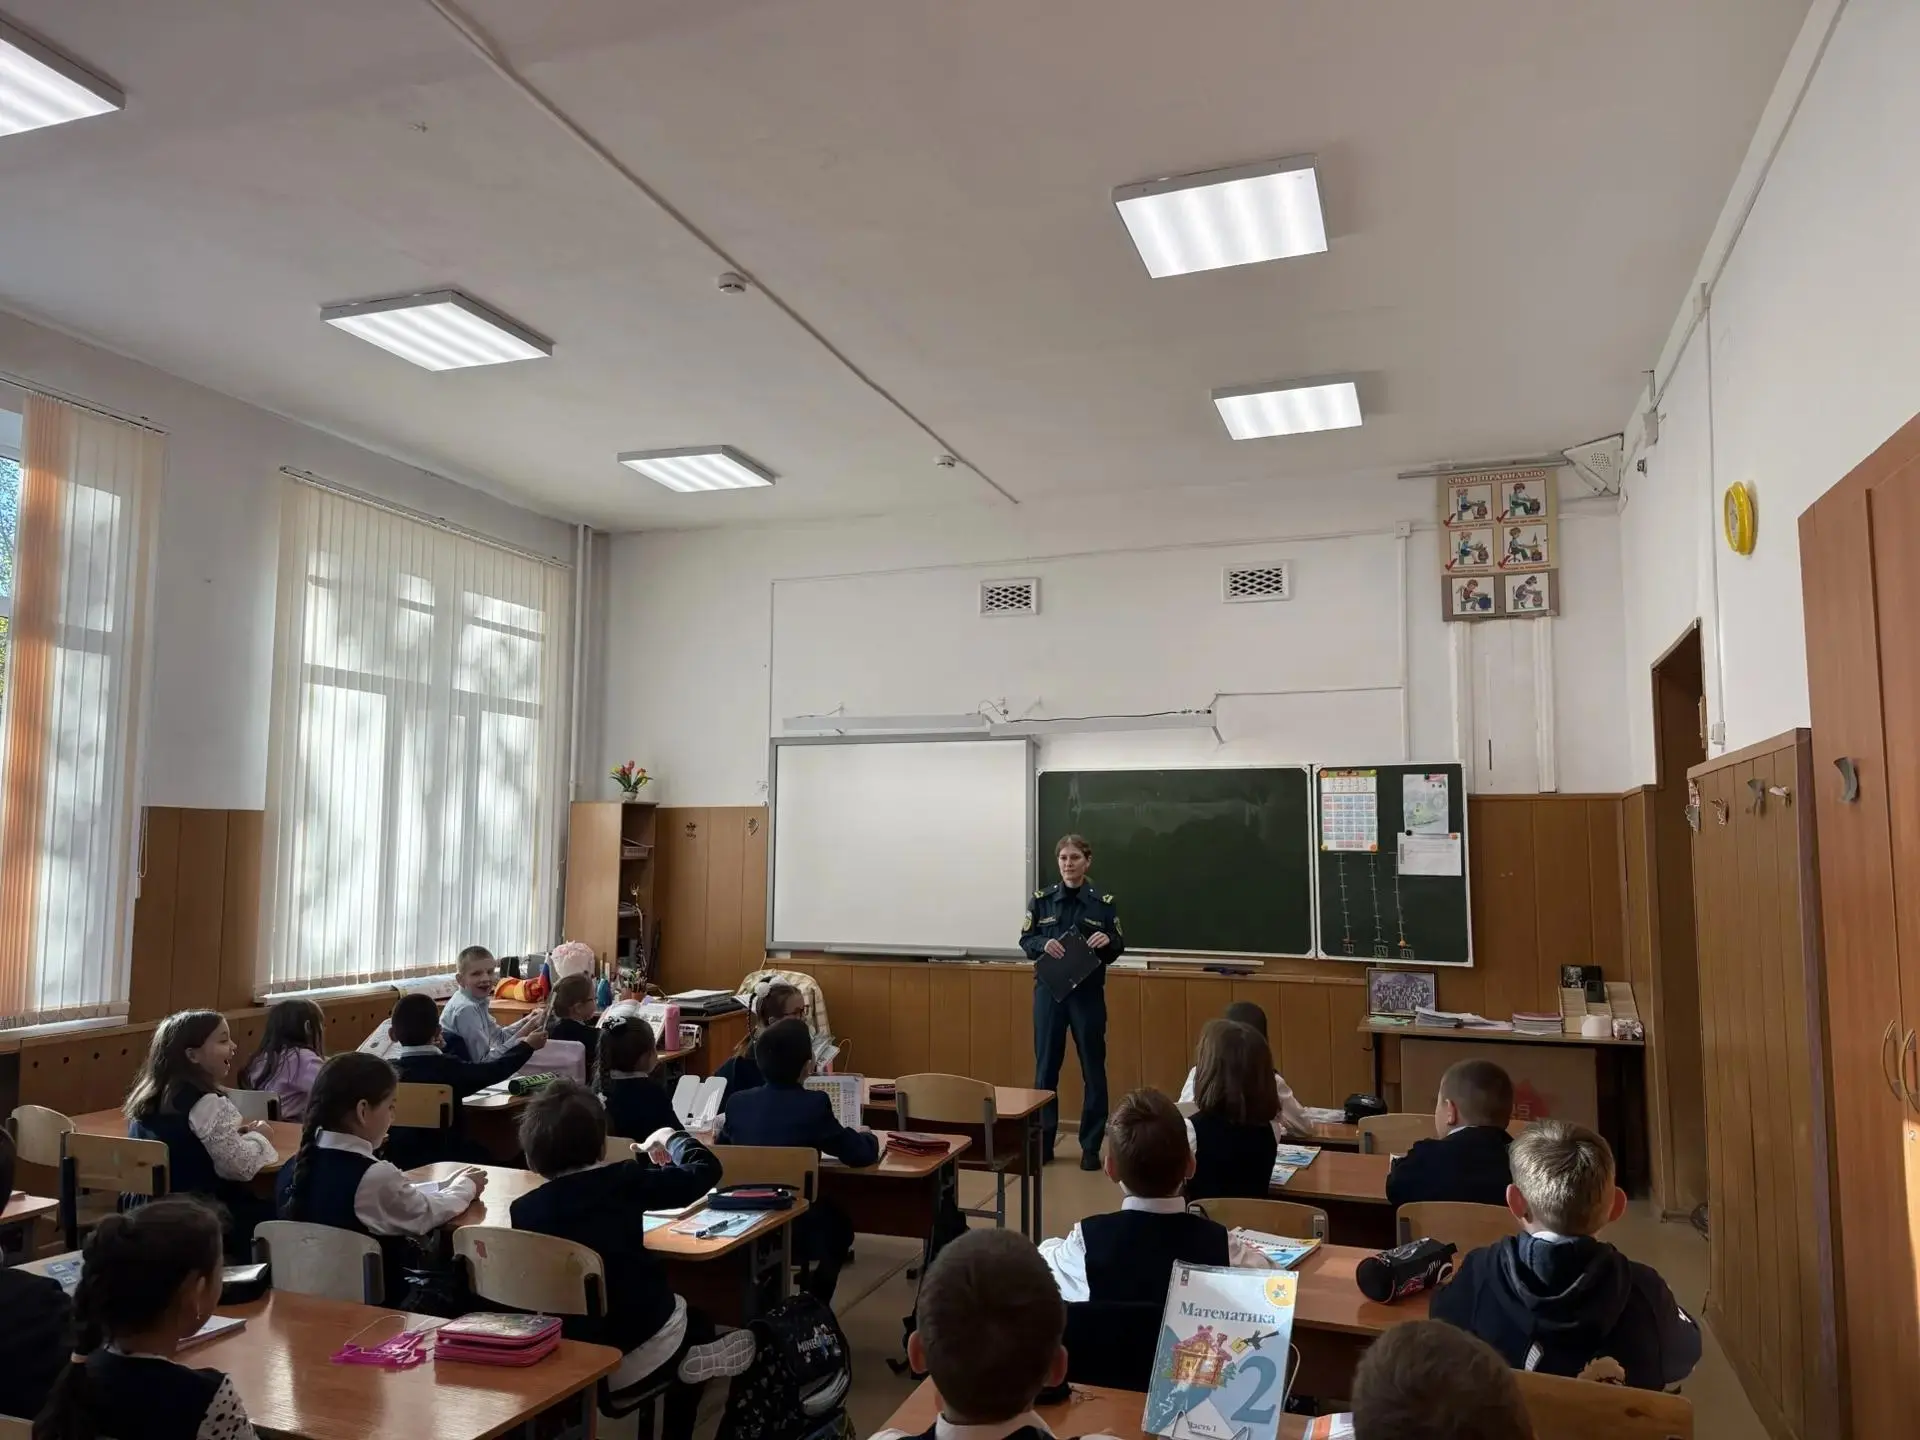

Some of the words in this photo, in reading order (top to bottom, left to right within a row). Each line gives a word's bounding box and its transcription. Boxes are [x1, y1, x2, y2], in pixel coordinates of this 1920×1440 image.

[1480, 469, 1546, 482] ПРАВИЛЬНО
[1179, 1301, 1276, 1325] Математика
[1230, 1355, 1277, 1424] 2
